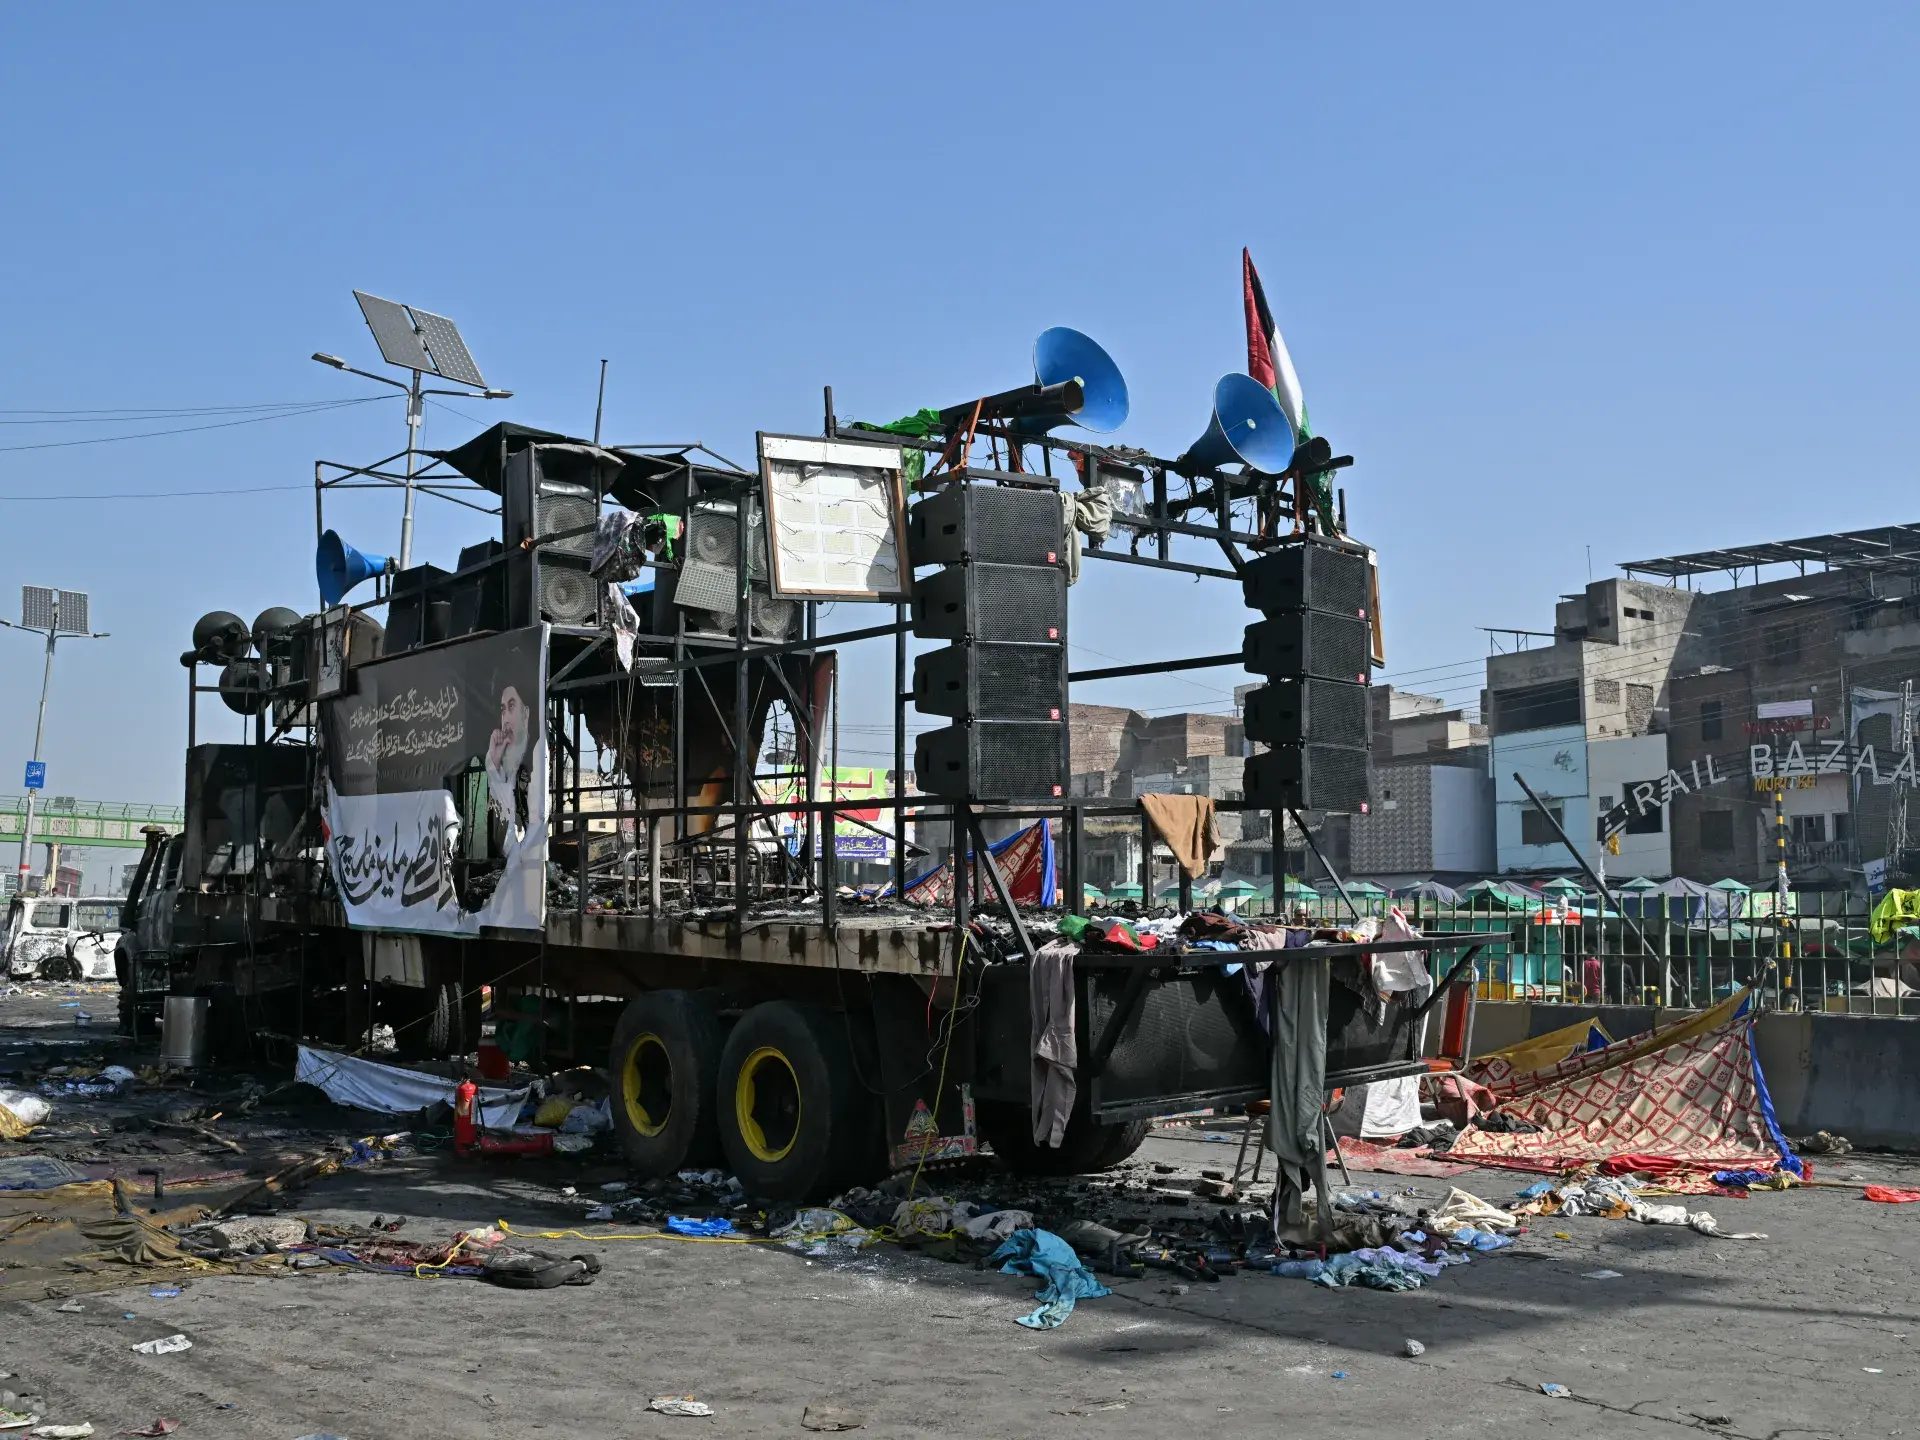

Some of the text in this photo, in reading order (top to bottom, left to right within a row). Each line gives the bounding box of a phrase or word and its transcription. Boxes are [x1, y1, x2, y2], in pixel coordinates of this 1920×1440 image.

[389, 694, 402, 720] کے
[434, 721, 464, 748] فلسطینی
[1632, 754, 1726, 817] RAIL
